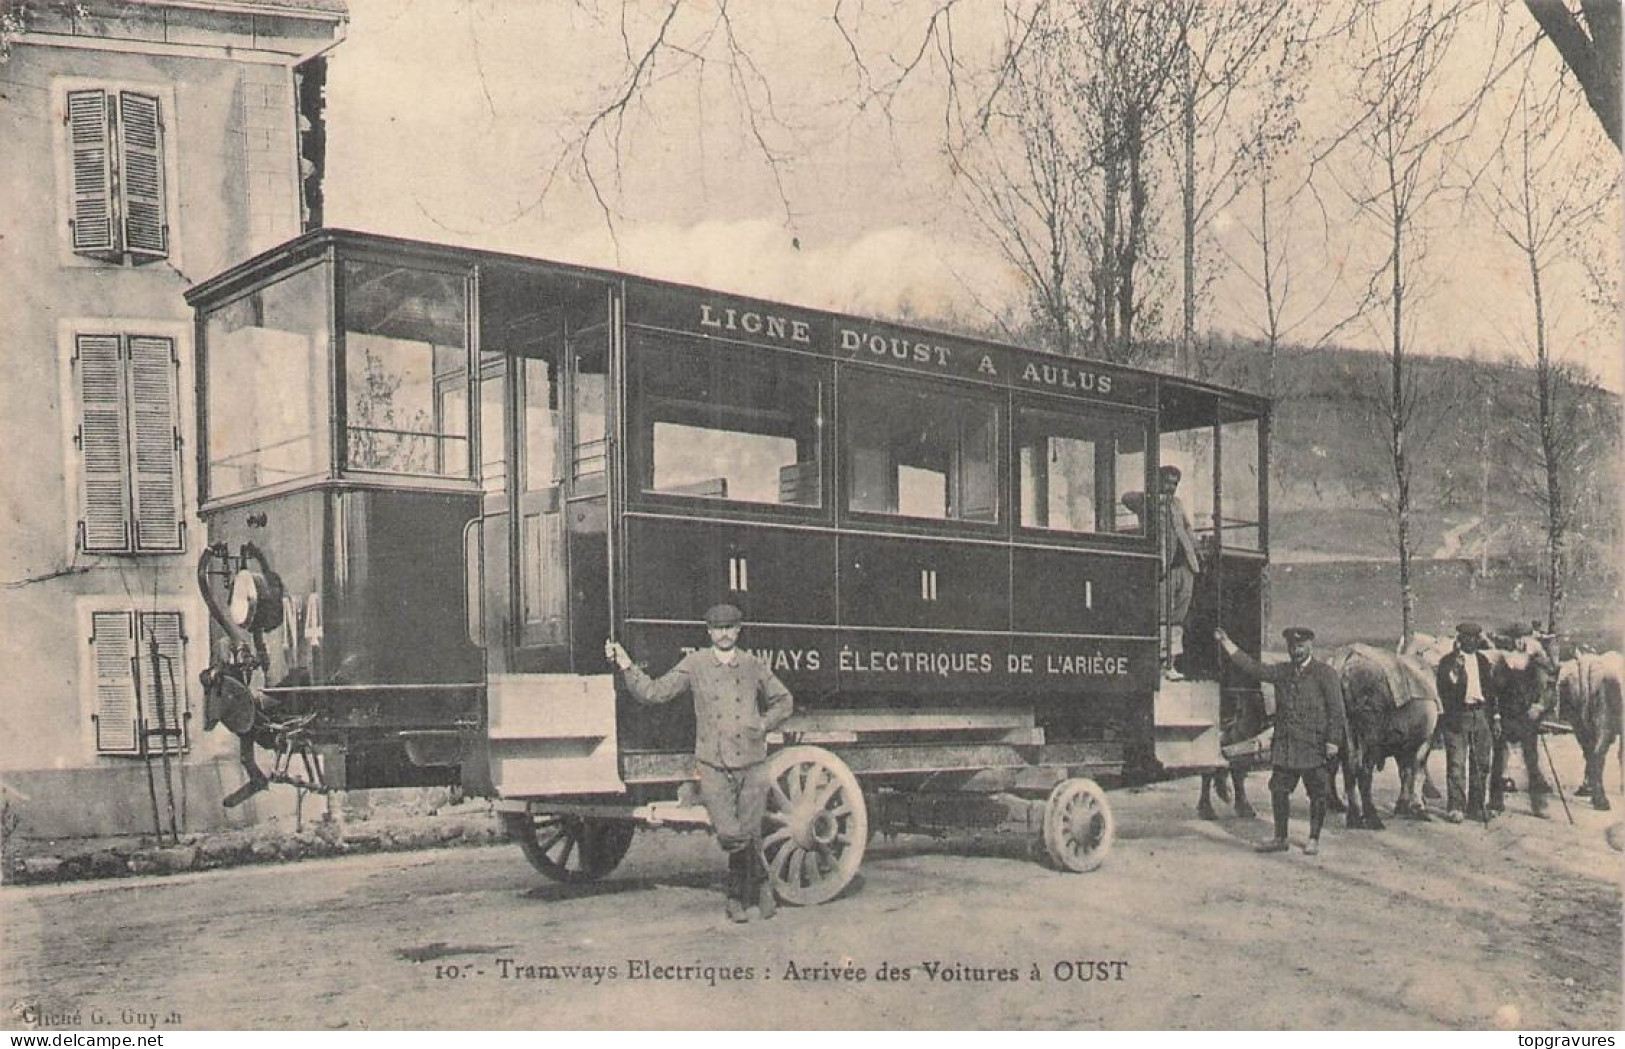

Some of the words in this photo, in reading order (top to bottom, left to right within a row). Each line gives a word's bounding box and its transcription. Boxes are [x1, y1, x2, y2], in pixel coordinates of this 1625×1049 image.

[700, 304, 810, 343] LIGNE
[840, 329, 951, 366] D'OUST
[978, 354, 997, 376] A
[1022, 363, 1112, 392] AULUS
[838, 644, 993, 677] ÉLECTRIQUES
[1007, 653, 1033, 673] DE
[1047, 650, 1129, 675] L'ARIÈGE
